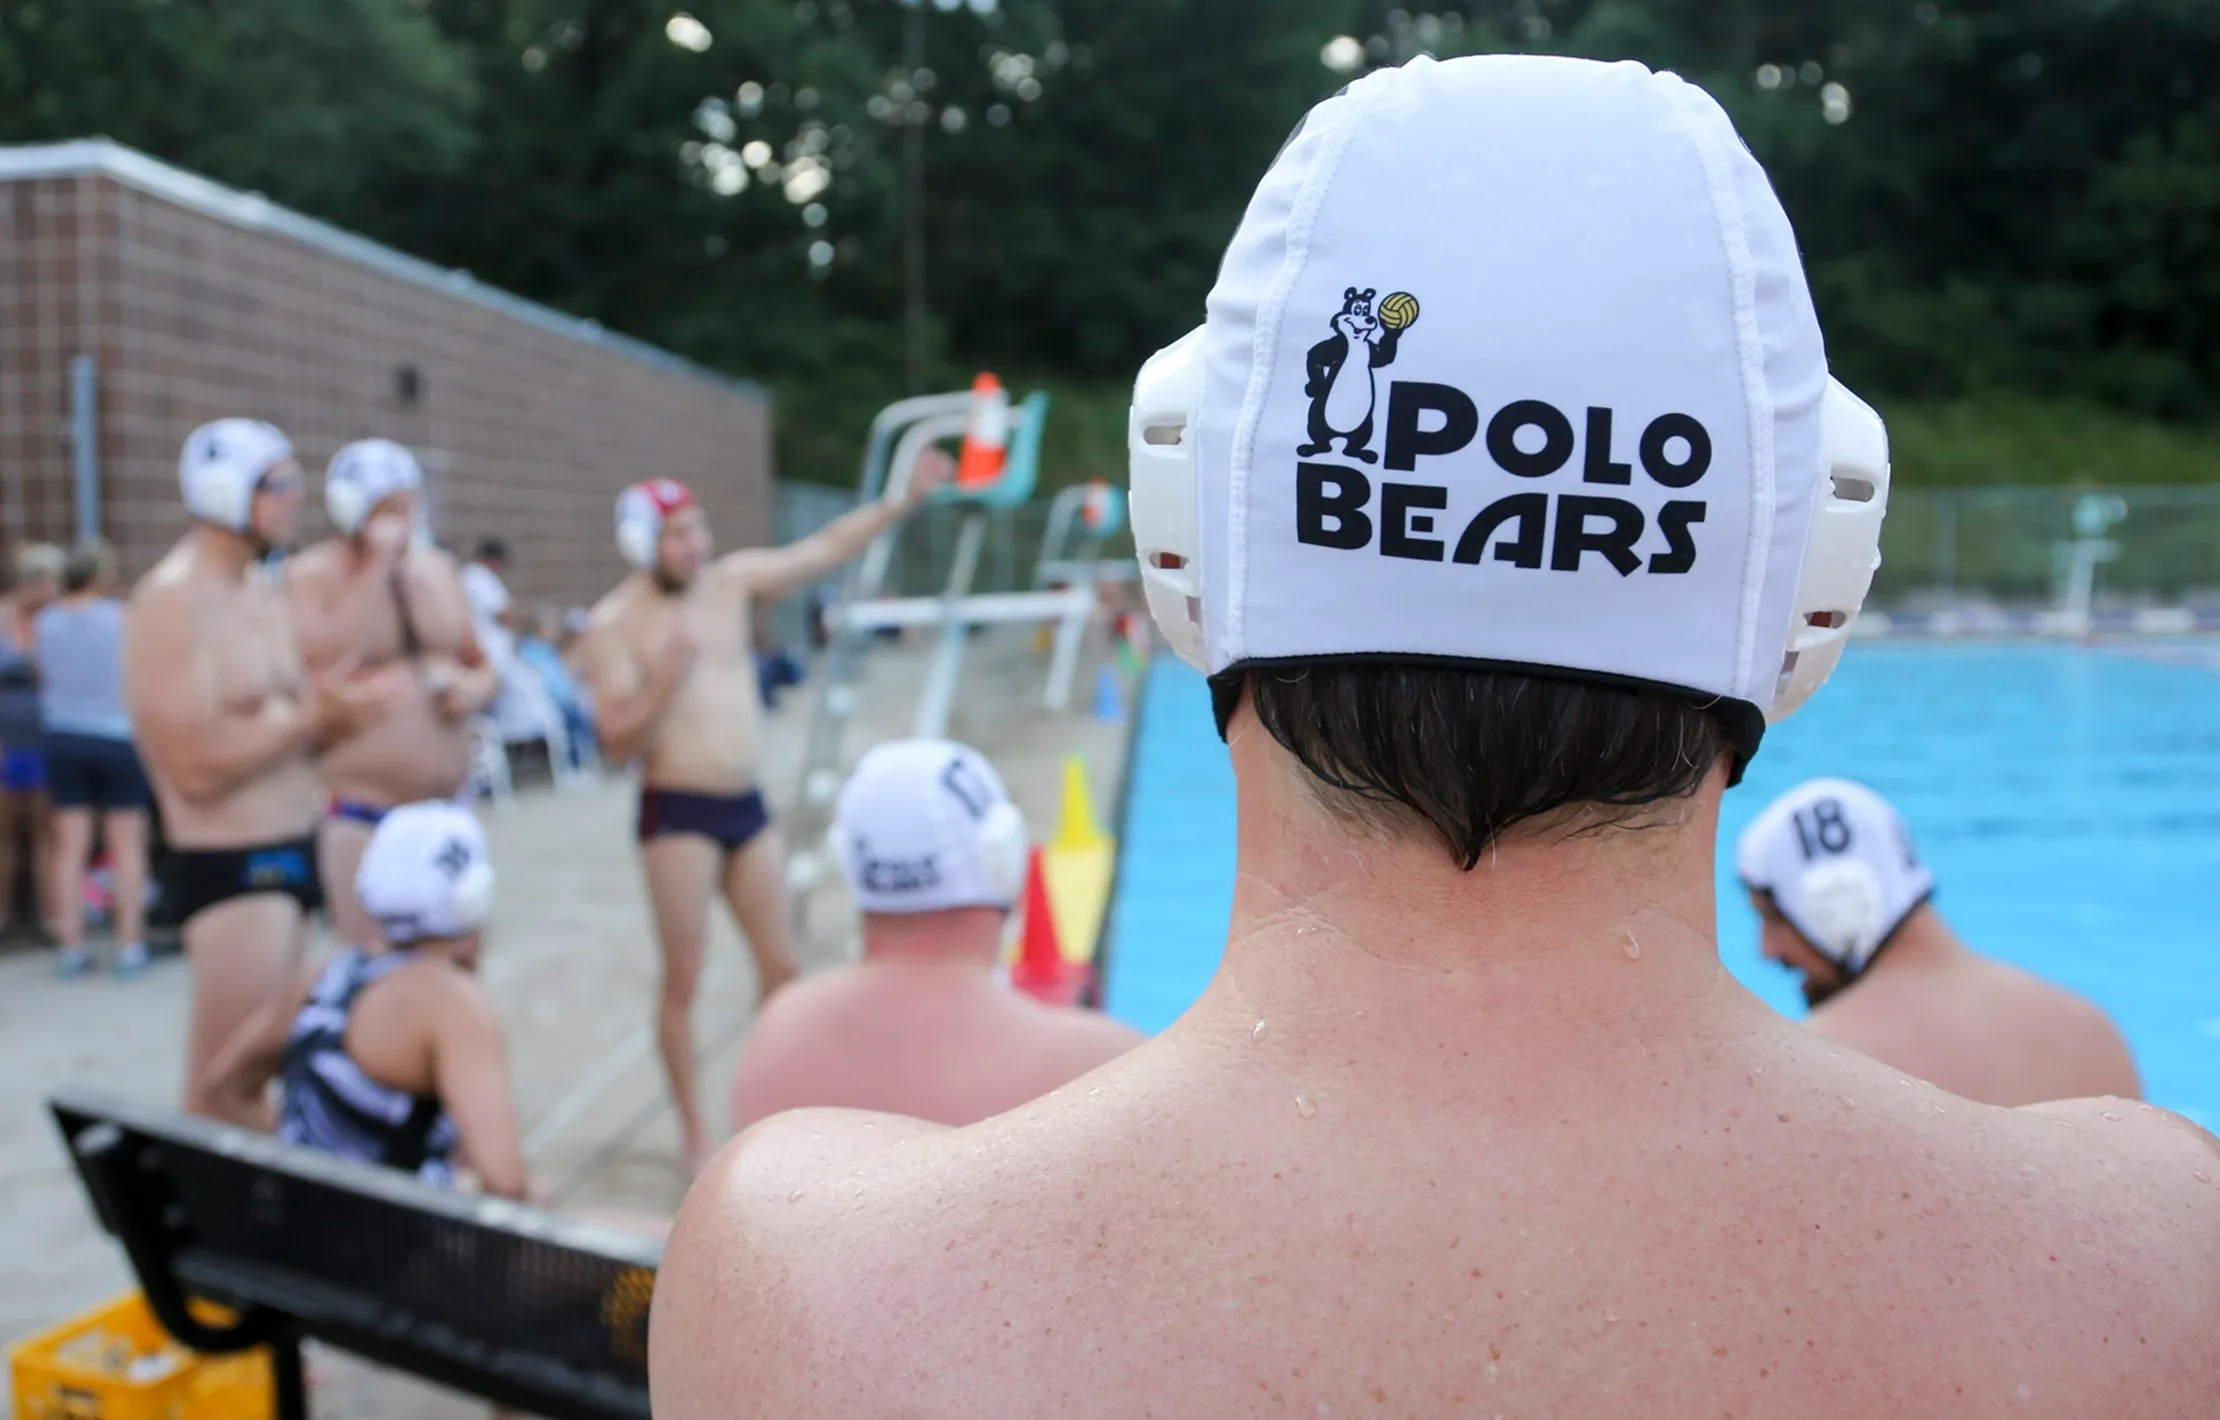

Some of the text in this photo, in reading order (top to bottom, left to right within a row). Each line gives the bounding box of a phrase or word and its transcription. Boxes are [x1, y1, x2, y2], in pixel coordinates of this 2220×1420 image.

[1383, 380, 1712, 488] POLO
[1296, 461, 1707, 577] BEARS
[1793, 799, 1852, 861] 18
